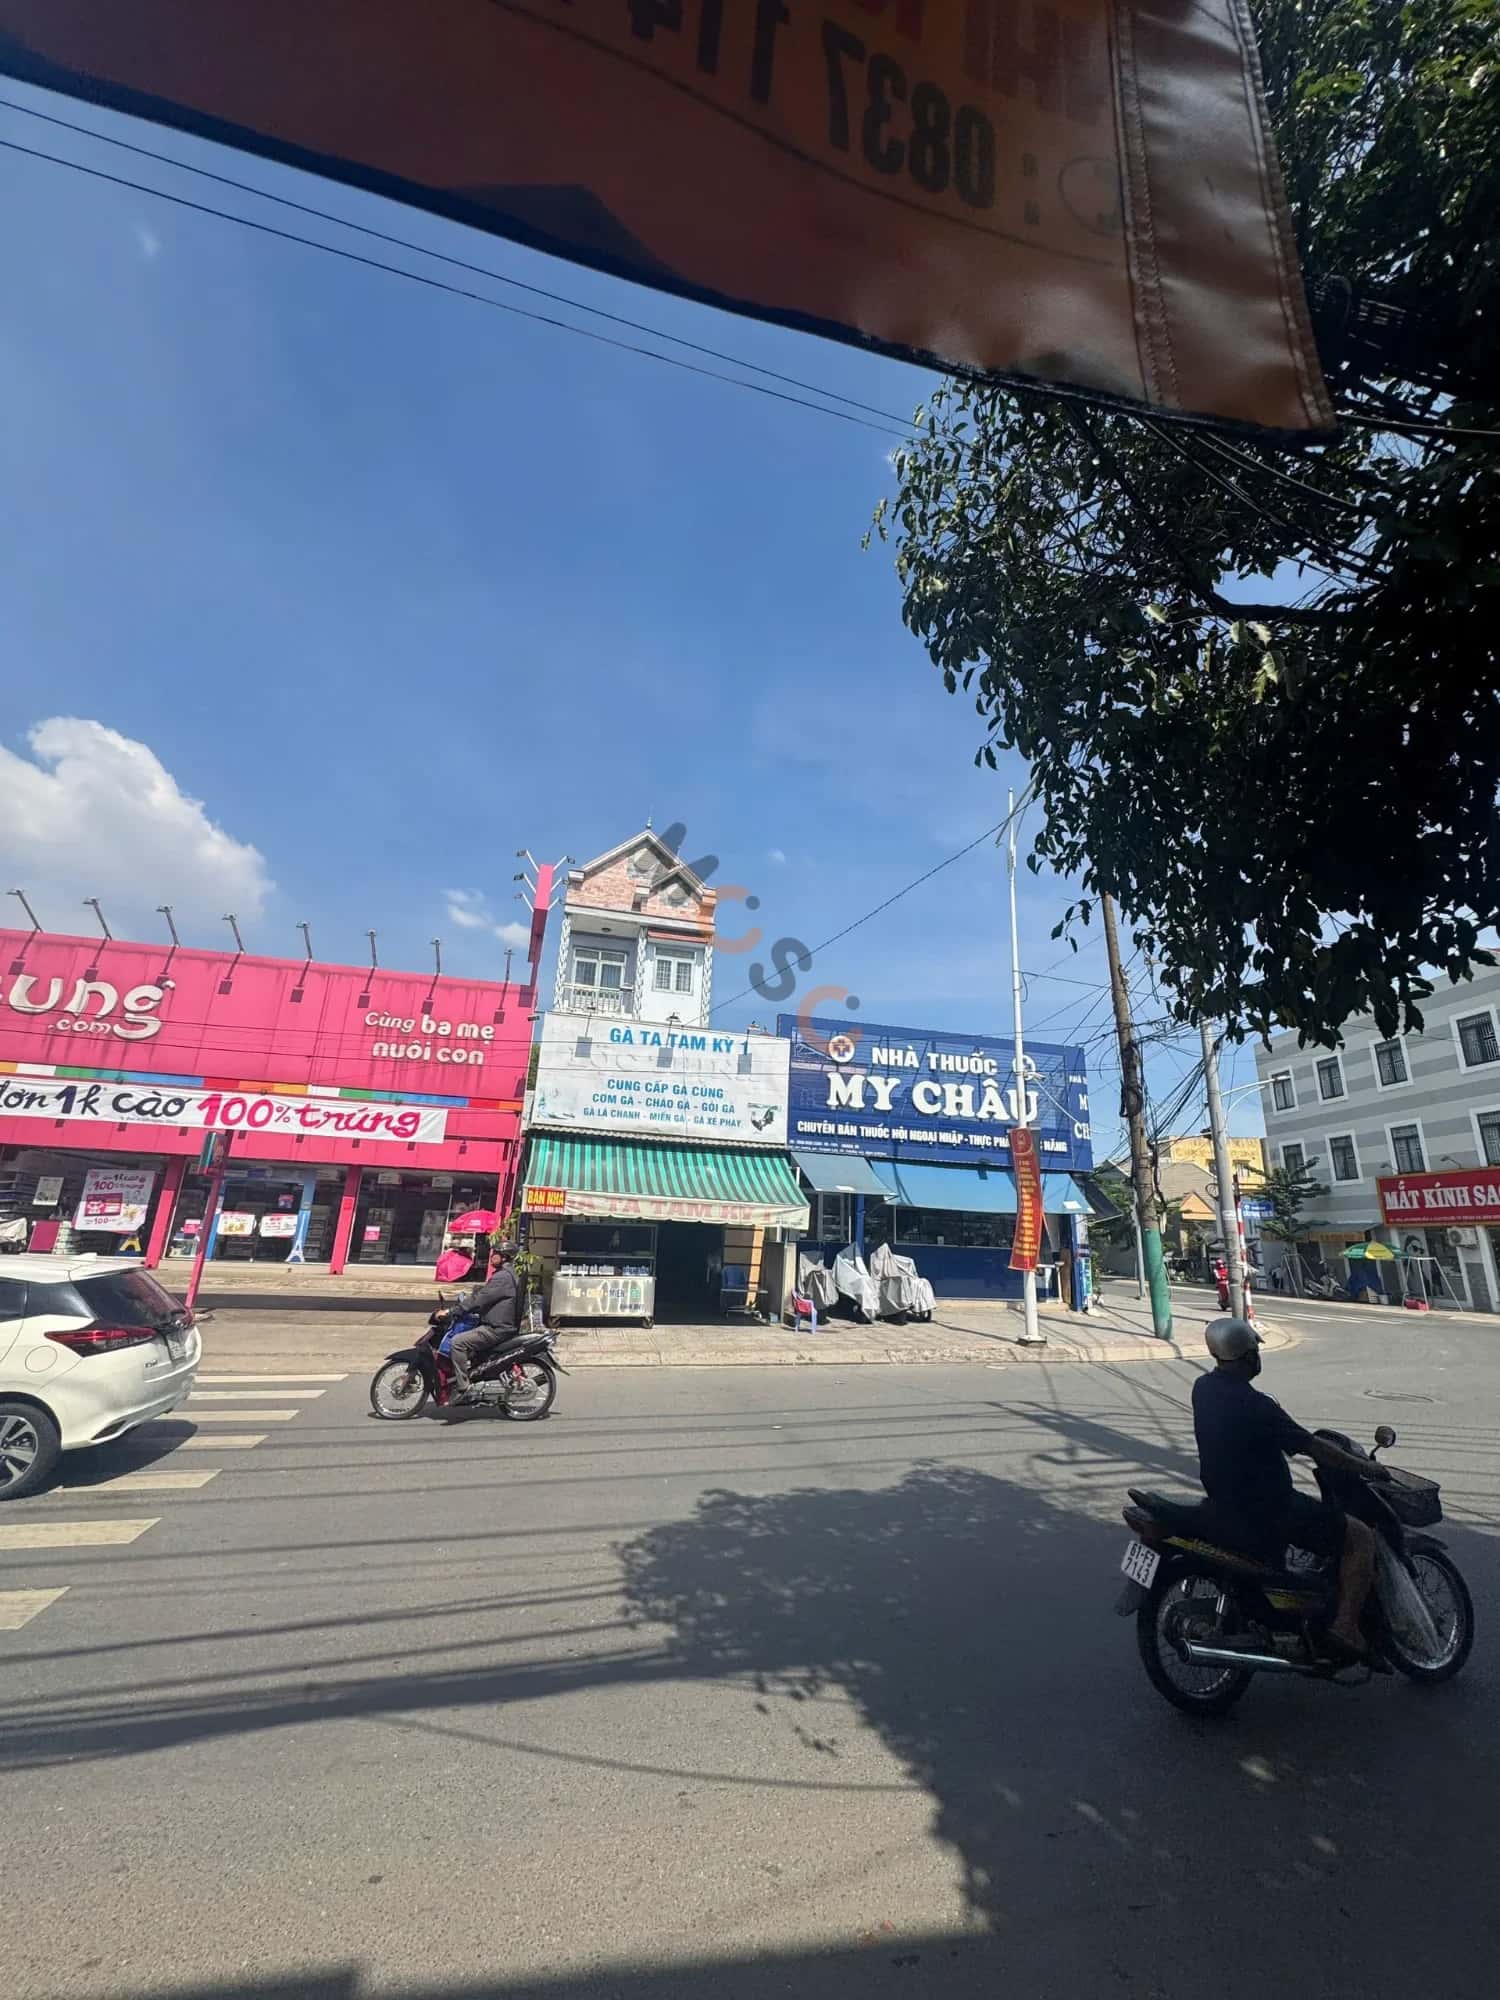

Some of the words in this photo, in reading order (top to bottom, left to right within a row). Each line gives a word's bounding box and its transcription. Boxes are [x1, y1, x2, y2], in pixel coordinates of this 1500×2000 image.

[0, 974, 164, 1040] ung
[48, 1018, 111, 1034] .com
[365, 1011, 416, 1033] Cùng
[421, 1014, 452, 1036] ba
[456, 1022, 495, 1045] mẹ
[610, 1026, 634, 1045] GÀ
[640, 1030, 662, 1046] TA
[668, 1033, 706, 1051] TAM
[739, 1040, 748, 1056] 1
[372, 1040, 432, 1061] nuôi
[436, 1047, 485, 1066] con
[872, 1046, 919, 1069] NHÀ
[927, 1052, 998, 1076] THUỐC
[607, 1079, 641, 1092] CUNG
[826, 1072, 901, 1111] MY
[912, 1078, 1039, 1122] CHÂU
[112, 1090, 192, 1118] cào
[293, 1102, 421, 1138] trúng
[797, 1120, 836, 1135] CHUYÊN
[837, 1121, 858, 1137] BÁN
[859, 1122, 890, 1139] THUỐC
[1422, 1181, 1472, 1209] KÍNH
[1473, 1184, 1500, 1207] SA
